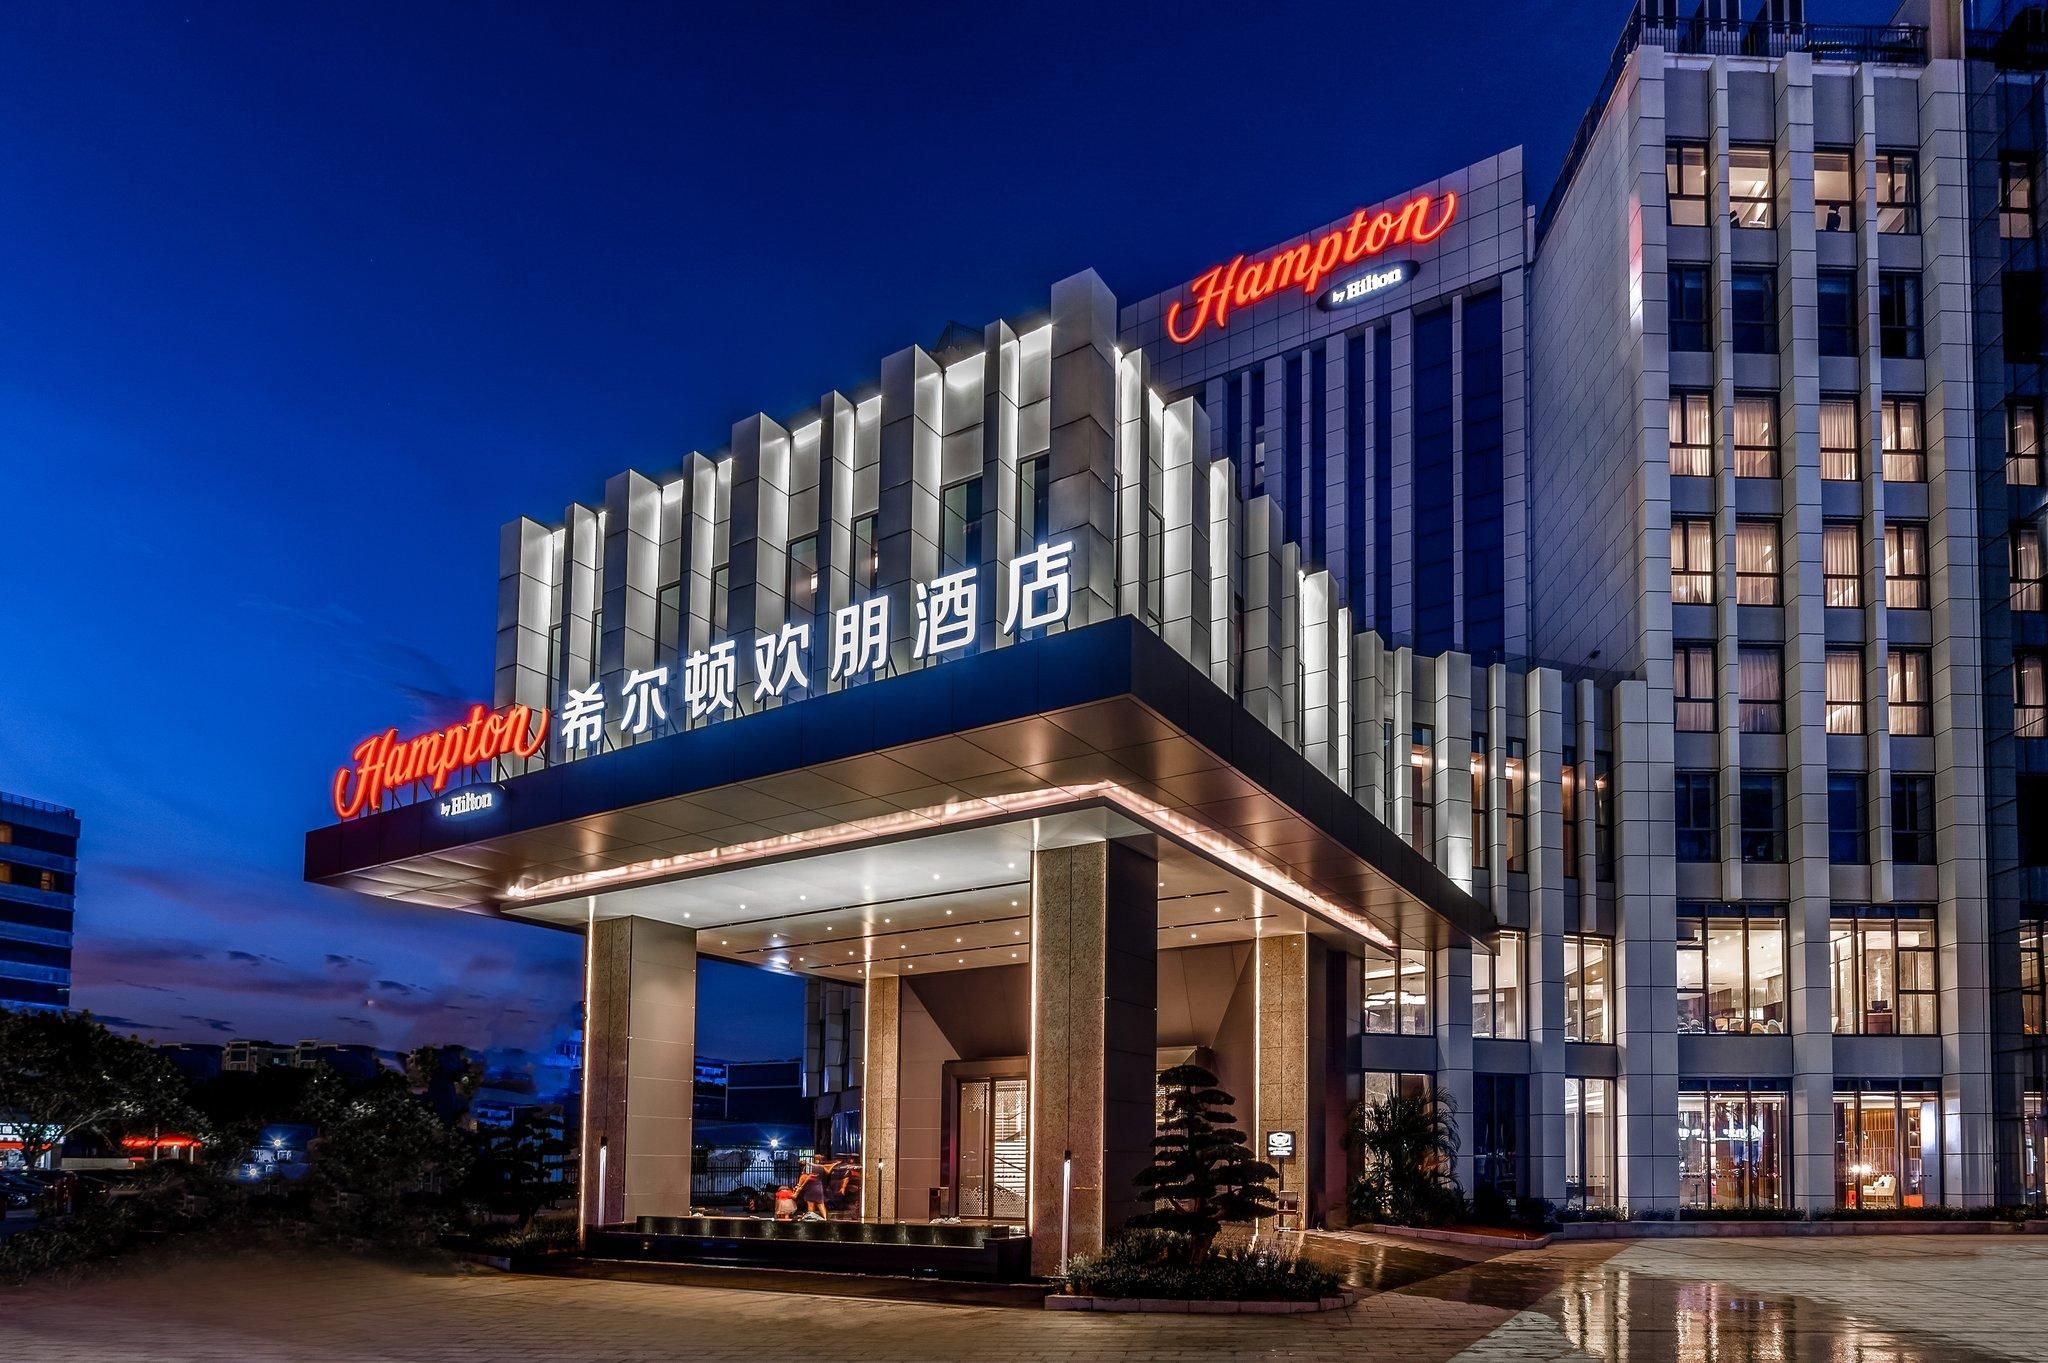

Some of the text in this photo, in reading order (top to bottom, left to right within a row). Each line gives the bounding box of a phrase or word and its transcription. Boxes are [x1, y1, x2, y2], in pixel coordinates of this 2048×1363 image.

[1168, 192, 1456, 342] Hampton
[1332, 268, 1402, 303] by Hilton
[561, 541, 1074, 750] 希尔顿欢朋酒店
[335, 705, 549, 817] Hampton
[440, 792, 492, 816] by Hilton
